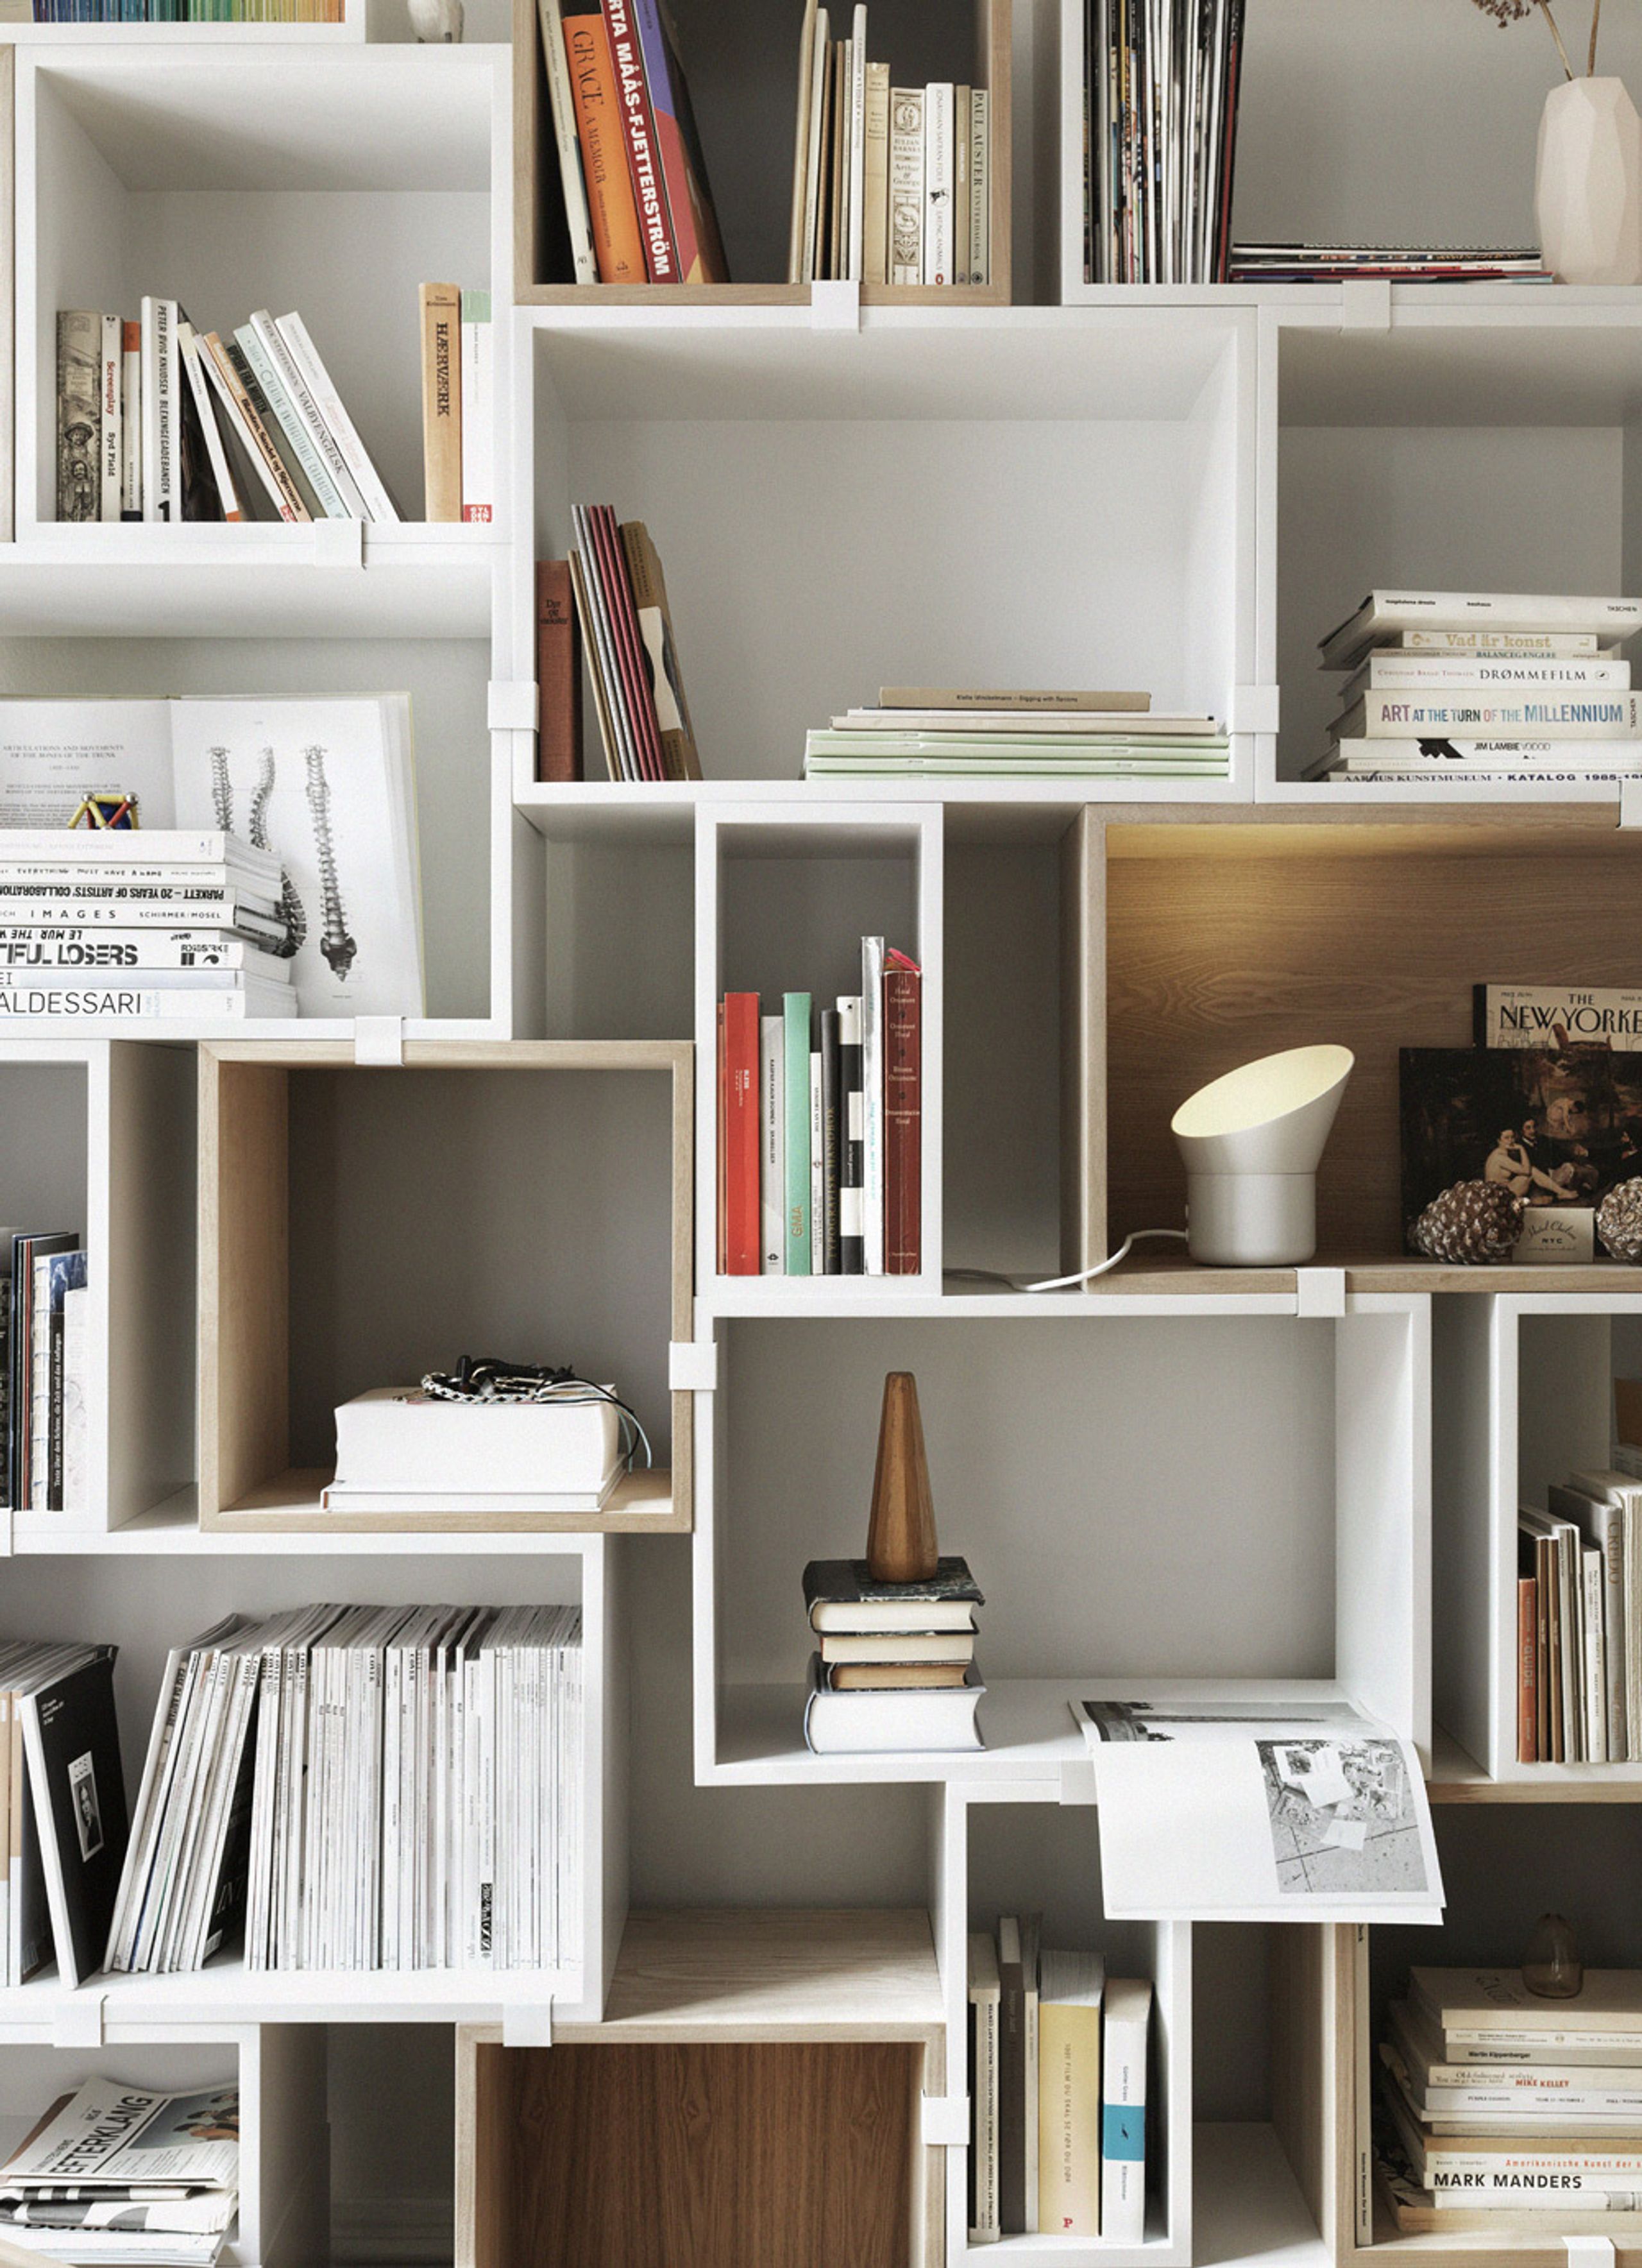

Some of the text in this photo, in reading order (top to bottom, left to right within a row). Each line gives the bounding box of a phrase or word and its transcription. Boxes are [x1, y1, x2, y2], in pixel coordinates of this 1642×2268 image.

[573, 31, 604, 110] GRACE
[585, 115, 597, 124] A
[974, 93, 984, 128] PAUL
[586, 126, 607, 184] MEMOIR
[616, 42, 670, 275] MÅÅS-FJETTERSTRÖM
[973, 134, 984, 186] AUSTER
[158, 305, 167, 331] PETER
[158, 356, 168, 395] KNUDSEN
[437, 322, 450, 416] HÆRVÆRK
[106, 361, 116, 416] Screenplay
[298, 390, 345, 475] VALBYENGELSK
[108, 452, 116, 477] Field
[1446, 634, 1552, 648] Vad är konst
[1480, 669, 1586, 680] DRØMMEFILM
[1382, 704, 1623, 722] ART AT THE TURN OF THE MILLENNIUM
[1474, 742, 1519, 751] JIM LAMBIE
[115, 887, 127, 898] OF
[130, 888, 159, 899] YEARS
[161, 888, 173, 899] 20
[183, 889, 224, 900] PARKETT
[31, 909, 117, 919] IMAGES
[11, 930, 83, 941] LE MUR THE
[58, 944, 139, 966] LOSERS
[1568, 993, 1595, 1005] THE
[1500, 1005, 1642, 1034] NEW YORKE
[1607, 1522, 1621, 1584] CREDO
[1064, 2085, 1071, 2095] DU
[49, 2095, 156, 2174] EFTERKLANG
[1064, 2152, 1071, 2163] DU
[1616, 2160, 1631, 2168] der
[1434, 2173, 1582, 2189] MARK MANDERS
